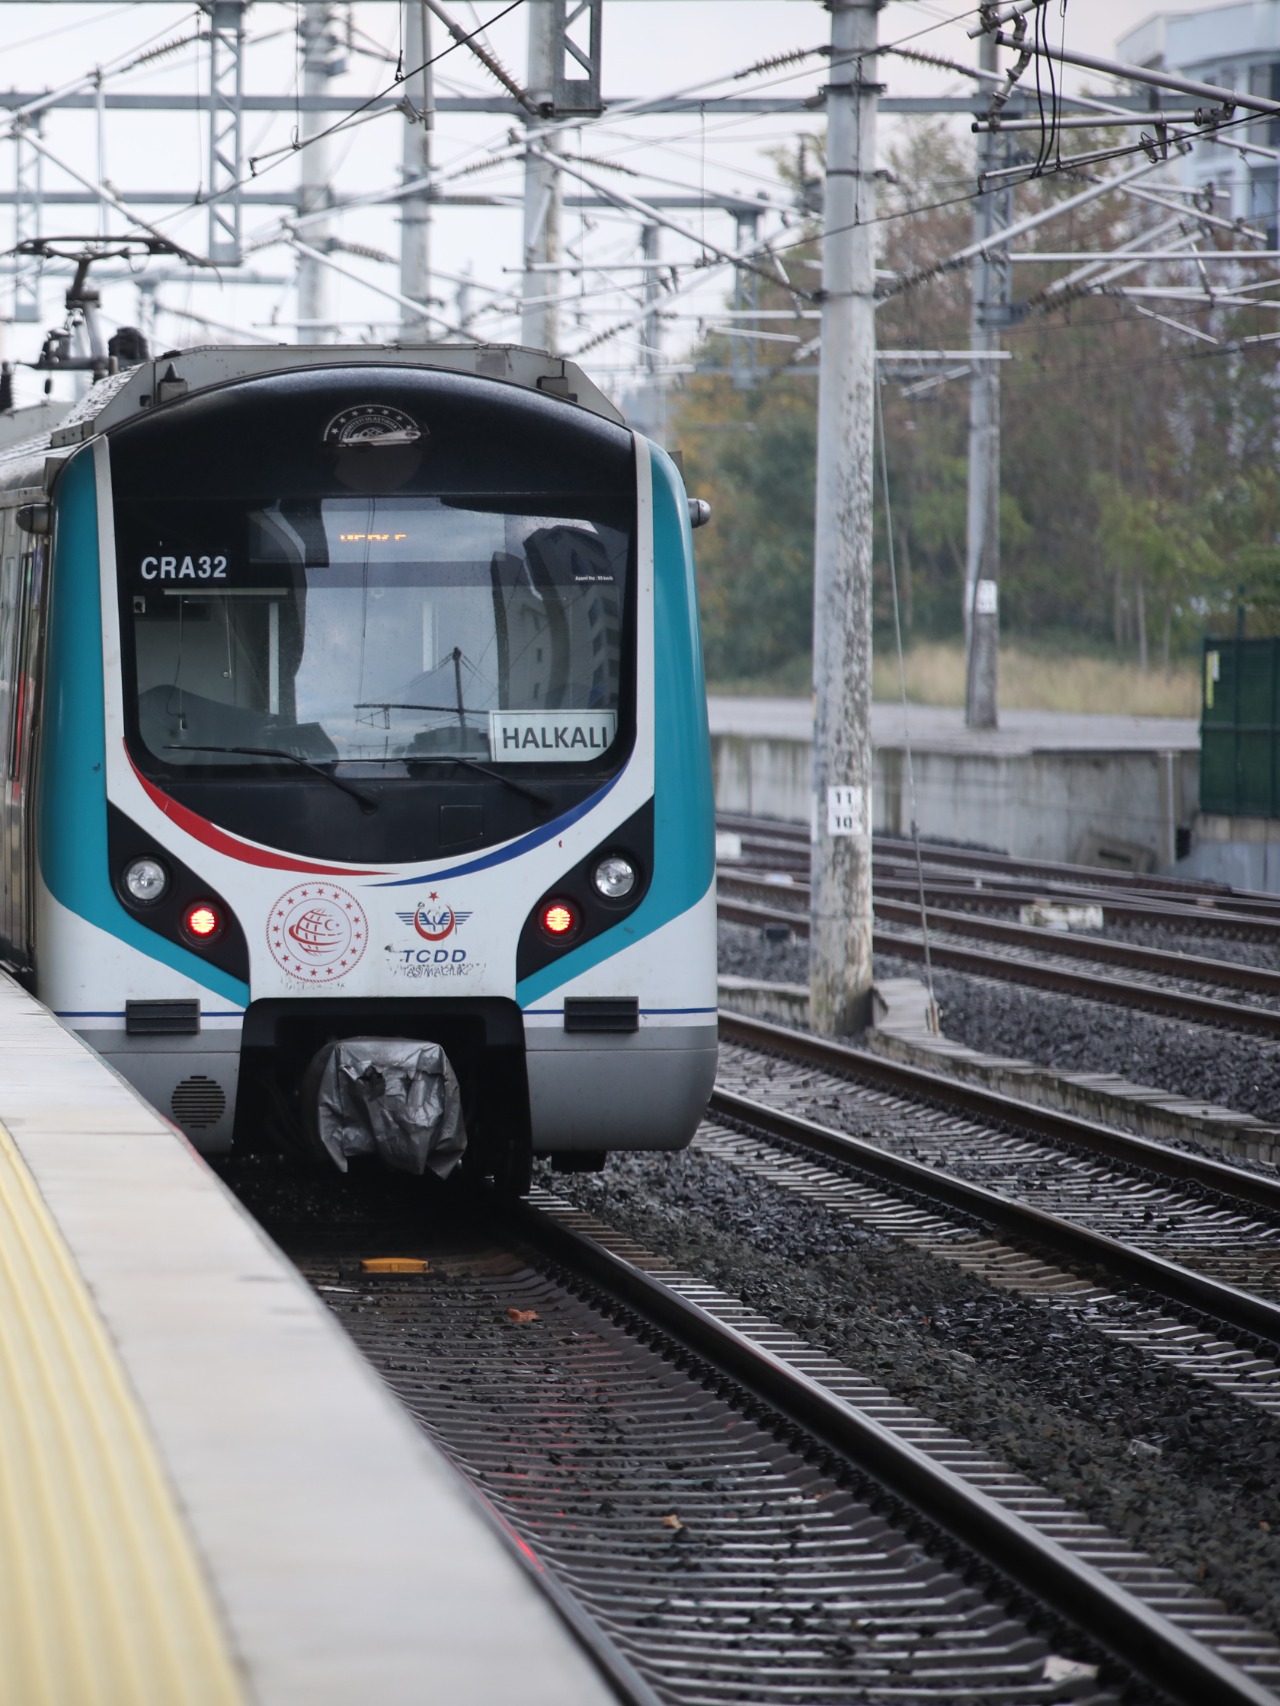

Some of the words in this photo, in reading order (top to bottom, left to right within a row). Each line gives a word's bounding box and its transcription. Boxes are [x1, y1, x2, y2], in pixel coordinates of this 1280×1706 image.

[141, 555, 228, 580] CRA32
[502, 726, 608, 749] HALKALI
[835, 791, 852, 805] 11
[403, 949, 467, 964] TCDD
